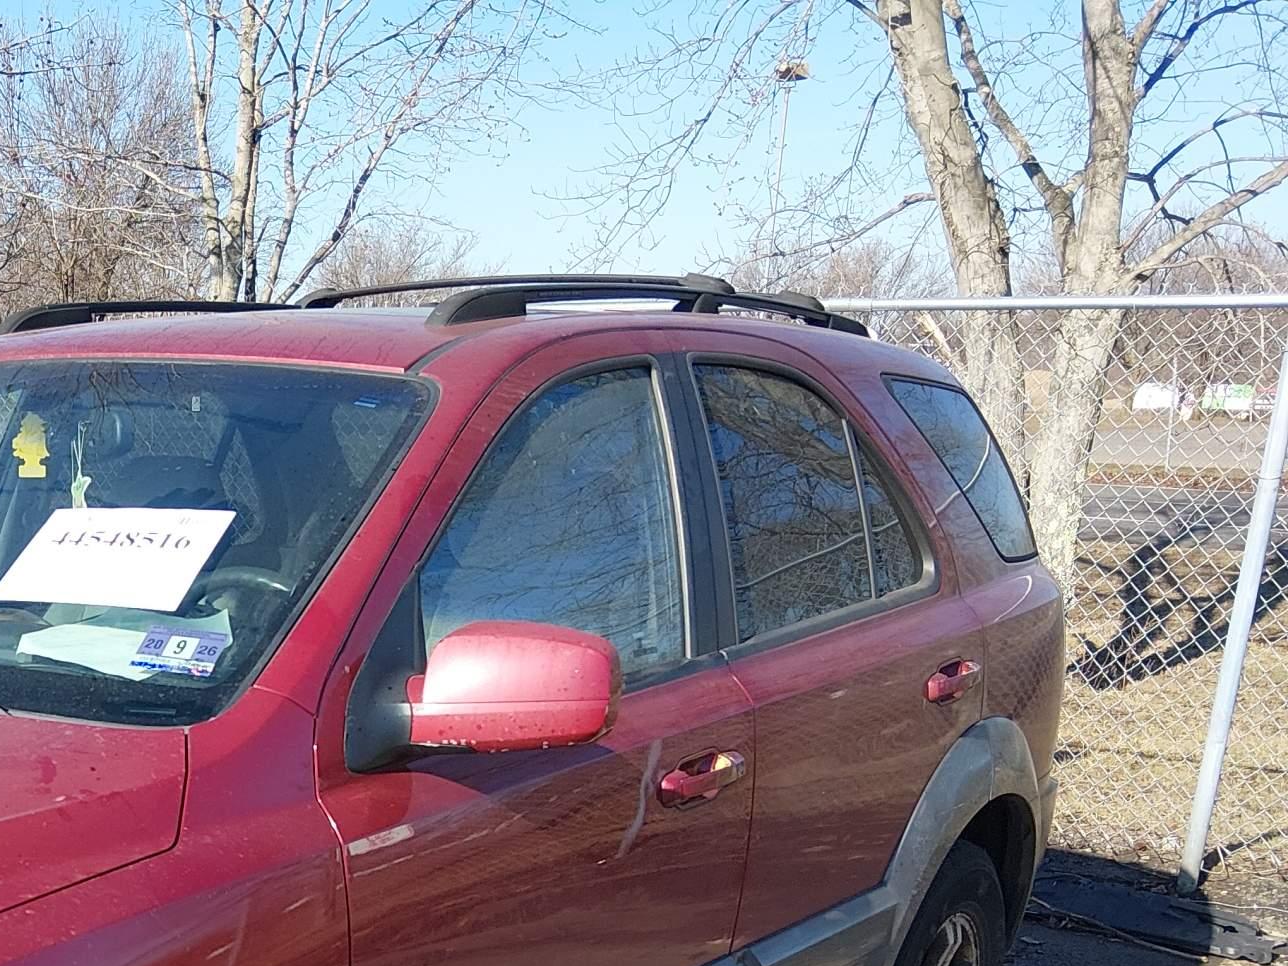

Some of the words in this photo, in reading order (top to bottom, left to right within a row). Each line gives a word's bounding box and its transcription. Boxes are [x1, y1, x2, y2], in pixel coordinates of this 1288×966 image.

[144, 638, 165, 650] 20
[172, 639, 188, 655] 9
[197, 645, 219, 657] 26
